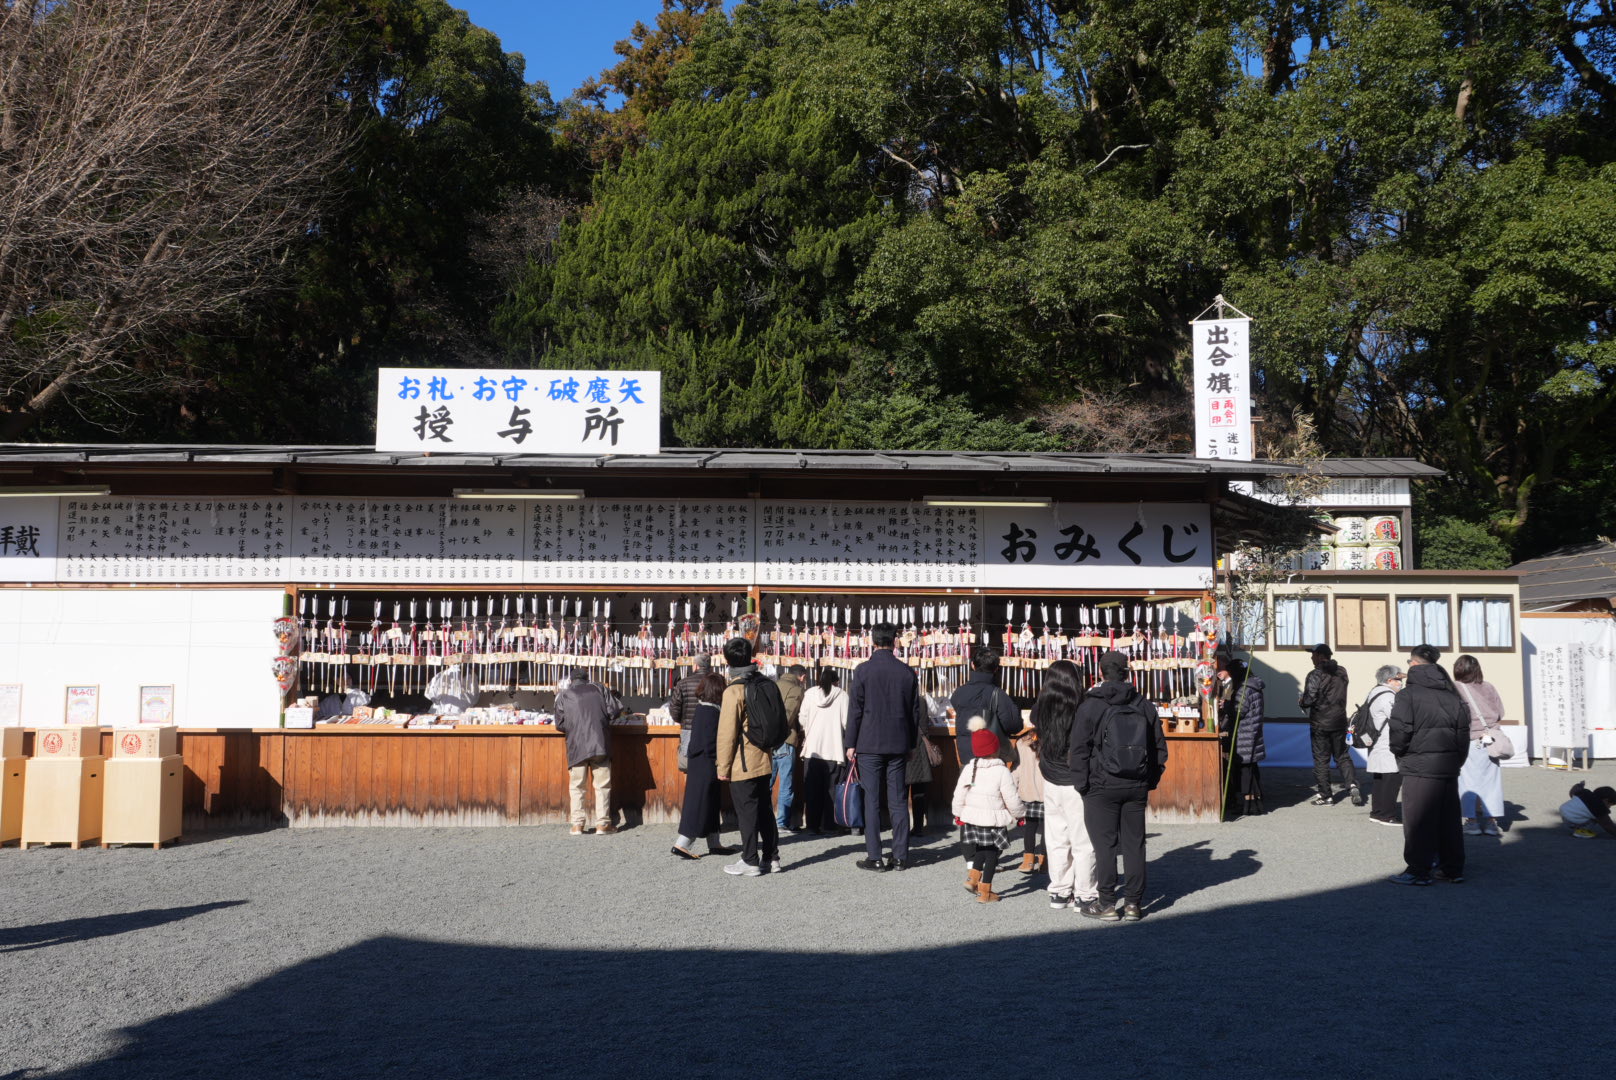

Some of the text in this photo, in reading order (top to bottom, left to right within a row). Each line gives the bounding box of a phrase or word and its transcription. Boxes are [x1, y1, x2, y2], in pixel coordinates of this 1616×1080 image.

[1207, 324, 1233, 394] 出合旗
[397, 375, 645, 405] お札・お守・破魔矢
[412, 404, 625, 447] 授与所
[1211, 400, 1222, 425] 目印
[1000, 521, 1199, 565] おみくじ
[1350, 521, 1363, 541] 新政
